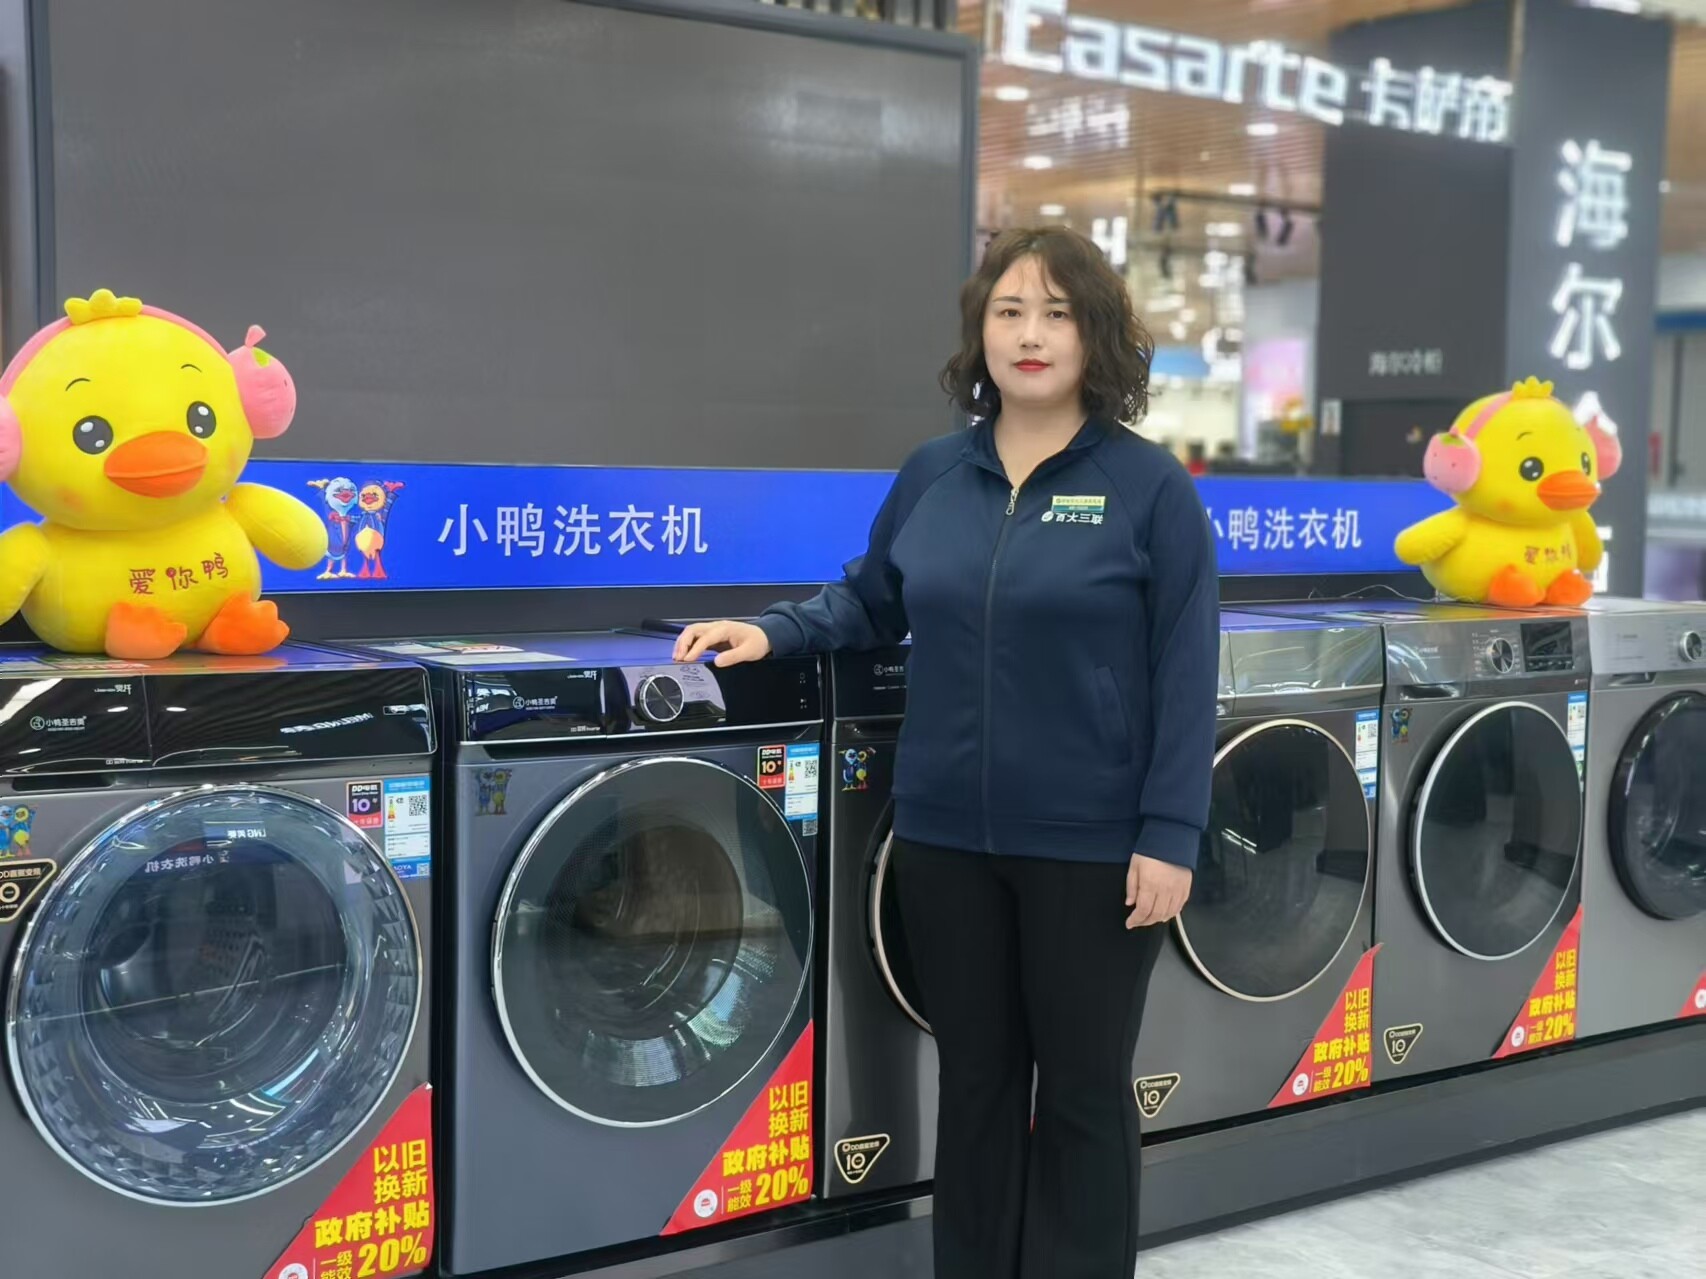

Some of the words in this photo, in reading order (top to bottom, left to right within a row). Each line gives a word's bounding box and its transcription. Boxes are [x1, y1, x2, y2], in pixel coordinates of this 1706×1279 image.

[1361, 57, 1513, 142] 卡萨帝
[437, 502, 709, 557] 小鸭洗衣机
[129, 552, 228, 594] 爱你鸭
[761, 760, 777, 774] 10
[352, 798, 371, 813] 10
[1345, 988, 1369, 1011] 以旧
[1344, 1008, 1369, 1034] 换新
[1543, 1012, 1574, 1041] 20%
[1314, 1031, 1370, 1064] 政府补贴
[1332, 1056, 1368, 1088] 20%
[769, 1081, 808, 1111] 以旧
[769, 1106, 809, 1138] 换新
[374, 1139, 427, 1174] 以旧
[723, 1134, 810, 1177] 政府补贴
[374, 1167, 428, 1204] 换新
[756, 1164, 809, 1206] 20%
[314, 1200, 430, 1248] 政府补贴
[320, 1250, 352, 1266] 一级
[357, 1232, 427, 1278] 20%
